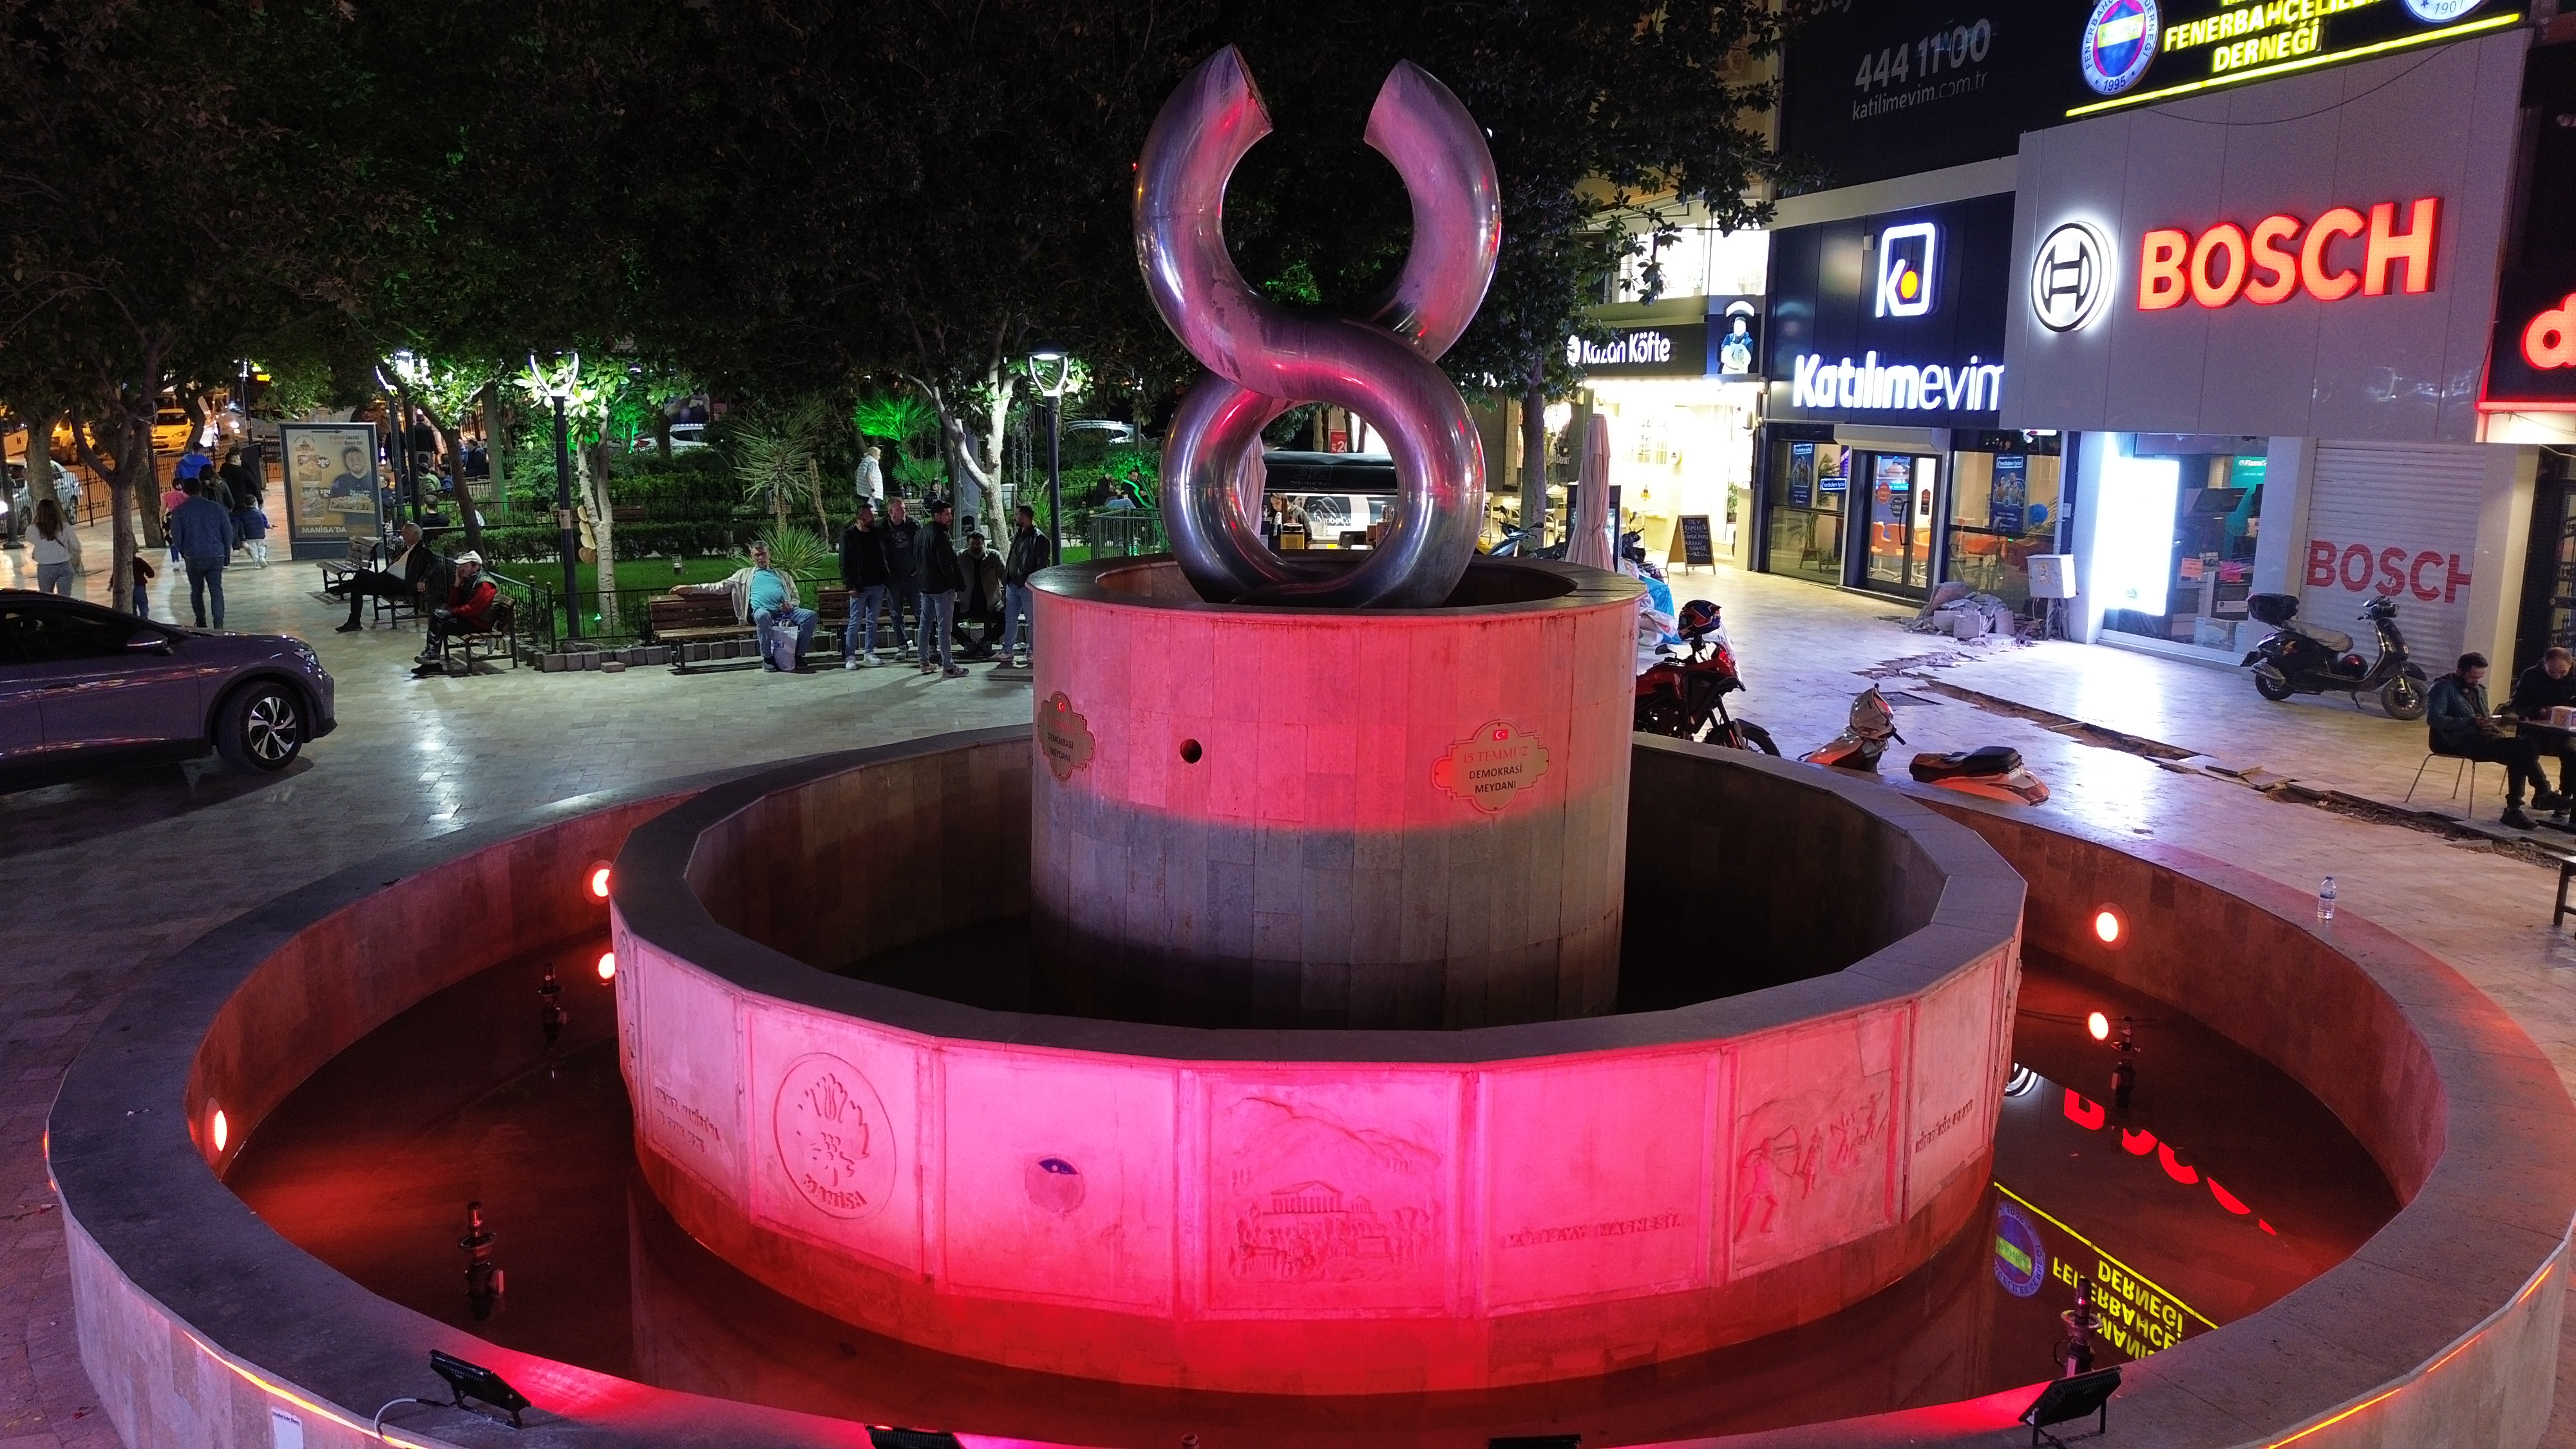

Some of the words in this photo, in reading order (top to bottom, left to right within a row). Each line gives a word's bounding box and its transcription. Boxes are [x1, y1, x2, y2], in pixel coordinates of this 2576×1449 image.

[2212, 18, 2320, 73] DERNEĞİ
[1855, 43, 1909, 92] 444
[2103, 75, 2126, 91] 1995
[2137, 196, 2439, 311] BOSCH
[1629, 331, 1671, 363] Köfte
[301, 526, 347, 534] MANİSA'DA
[1477, 746, 1528, 762] TEMMUZ
[1469, 762, 1522, 779] DEMOKRASİ
[1475, 781, 1517, 793] MEYDANI
